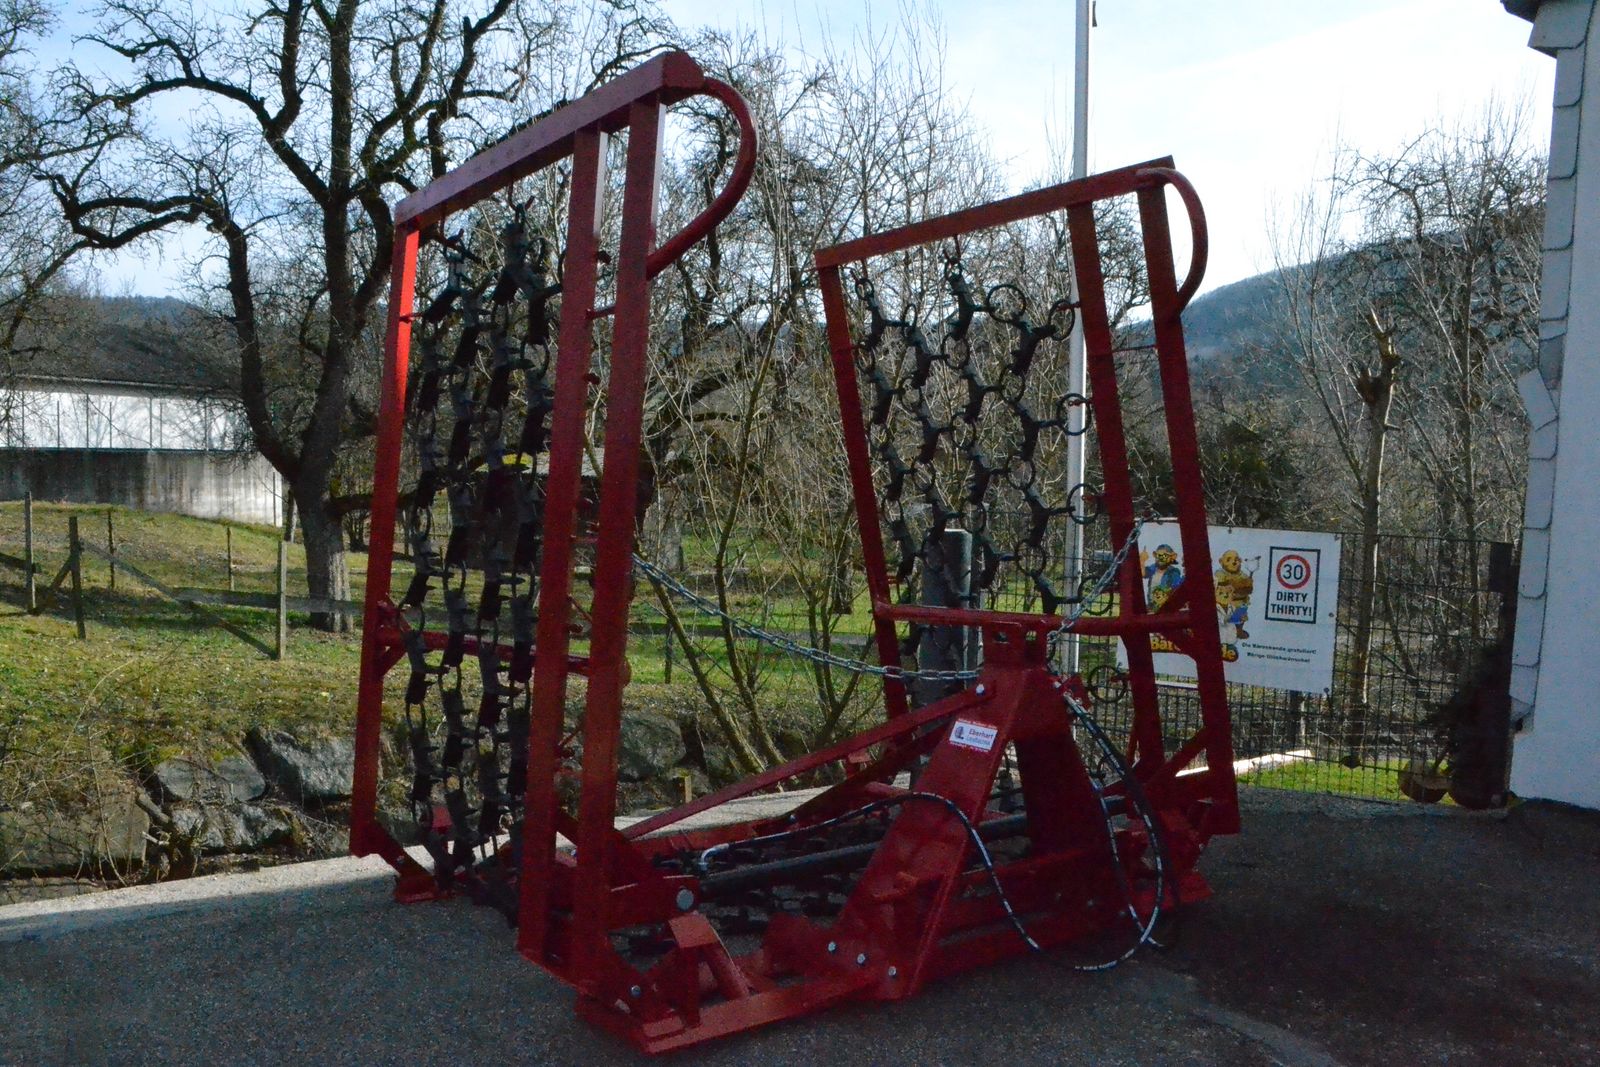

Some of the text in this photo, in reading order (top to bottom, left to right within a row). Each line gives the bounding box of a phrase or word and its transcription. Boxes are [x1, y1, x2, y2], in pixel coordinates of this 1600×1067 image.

[1283, 564, 1303, 580] 30
[1277, 591, 1308, 603] DIRTY
[1271, 603, 1312, 617] THIRTY!
